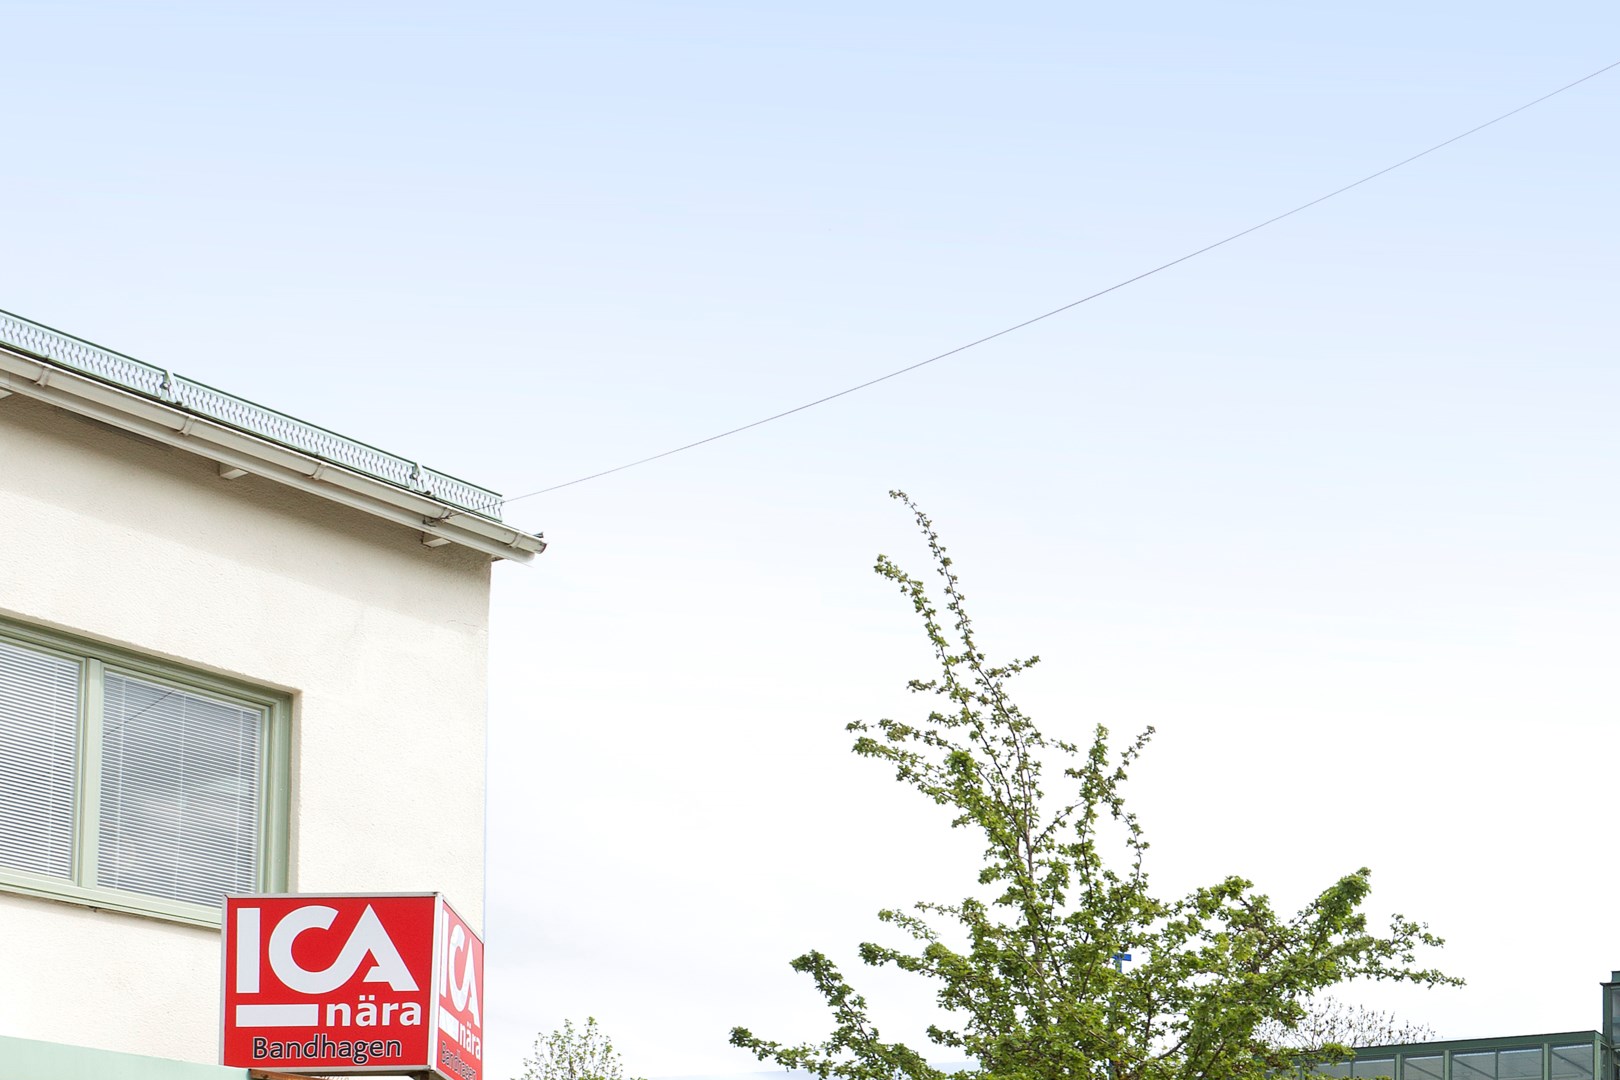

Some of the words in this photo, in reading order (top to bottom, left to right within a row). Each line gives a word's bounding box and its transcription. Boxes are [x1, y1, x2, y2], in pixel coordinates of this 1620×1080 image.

[236, 903, 420, 995] ICA
[440, 909, 481, 1029] ICA
[326, 995, 421, 1027] nära
[252, 1034, 402, 1064] Bandhagen
[460, 1020, 481, 1061] nära
